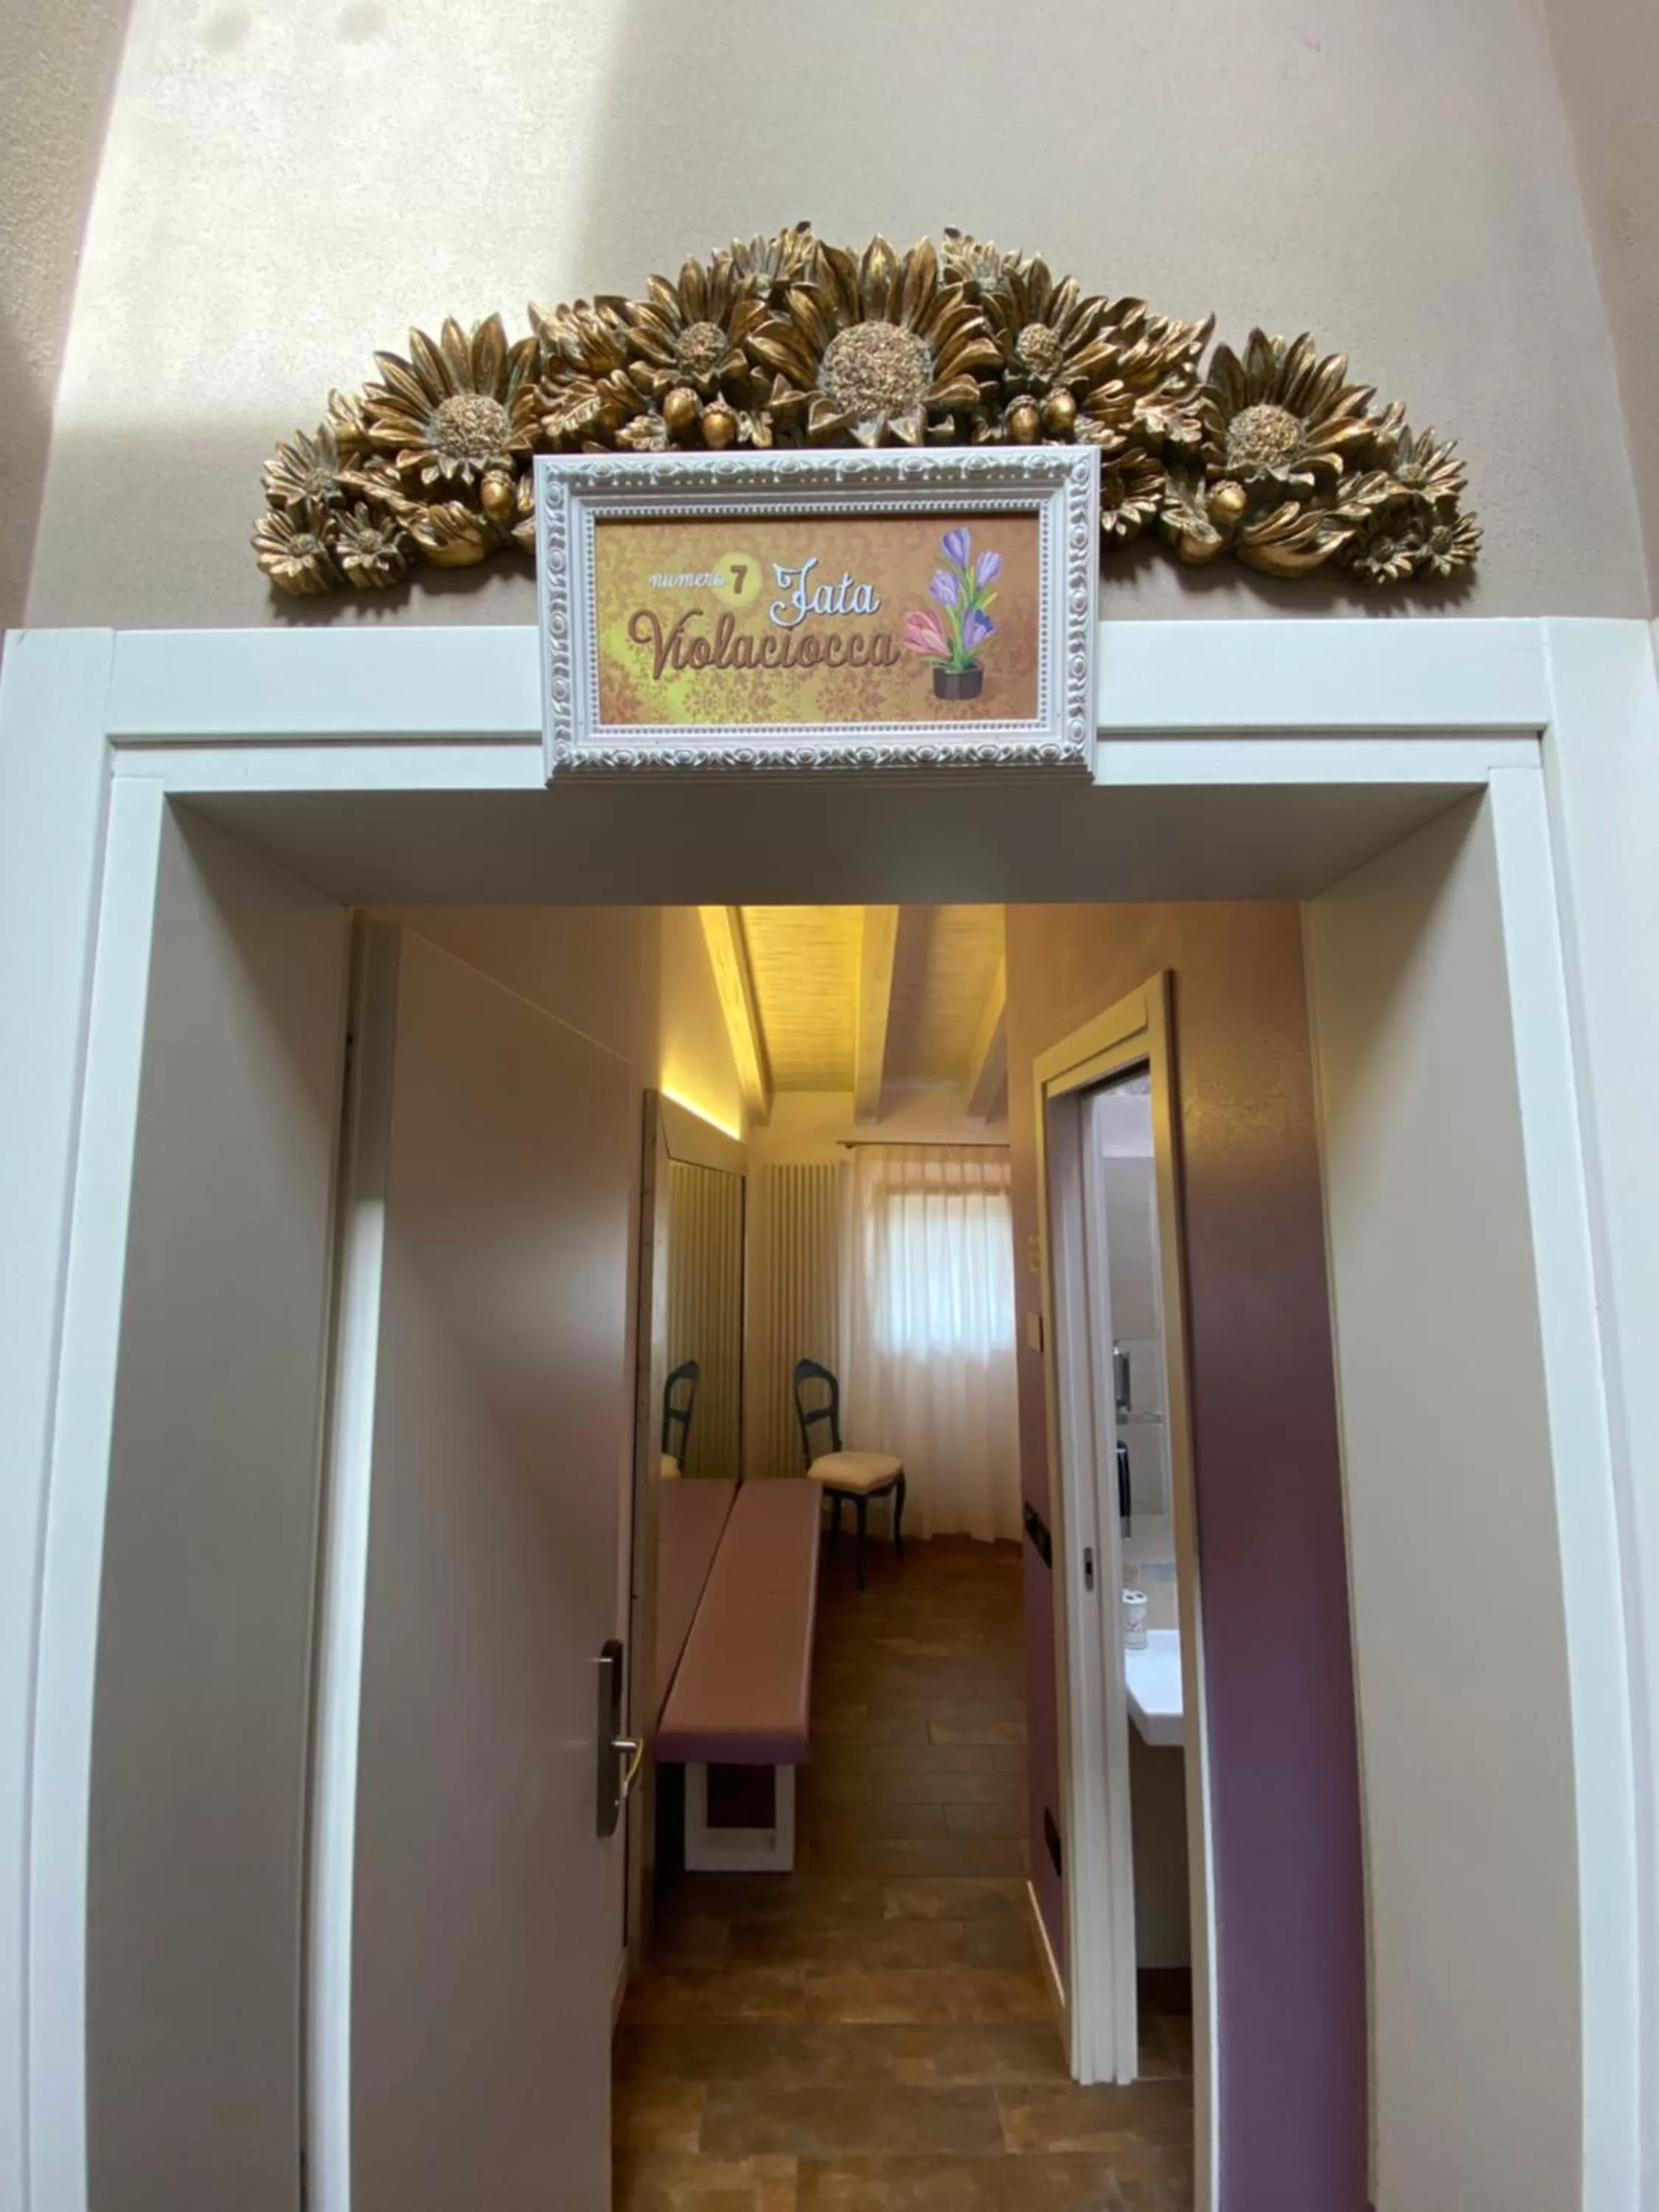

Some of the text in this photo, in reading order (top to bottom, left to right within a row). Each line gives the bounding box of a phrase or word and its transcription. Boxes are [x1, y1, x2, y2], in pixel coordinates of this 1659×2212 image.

[648, 572, 725, 588] numero
[730, 565, 748, 594] 7
[627, 609, 901, 681] Violaciocca
